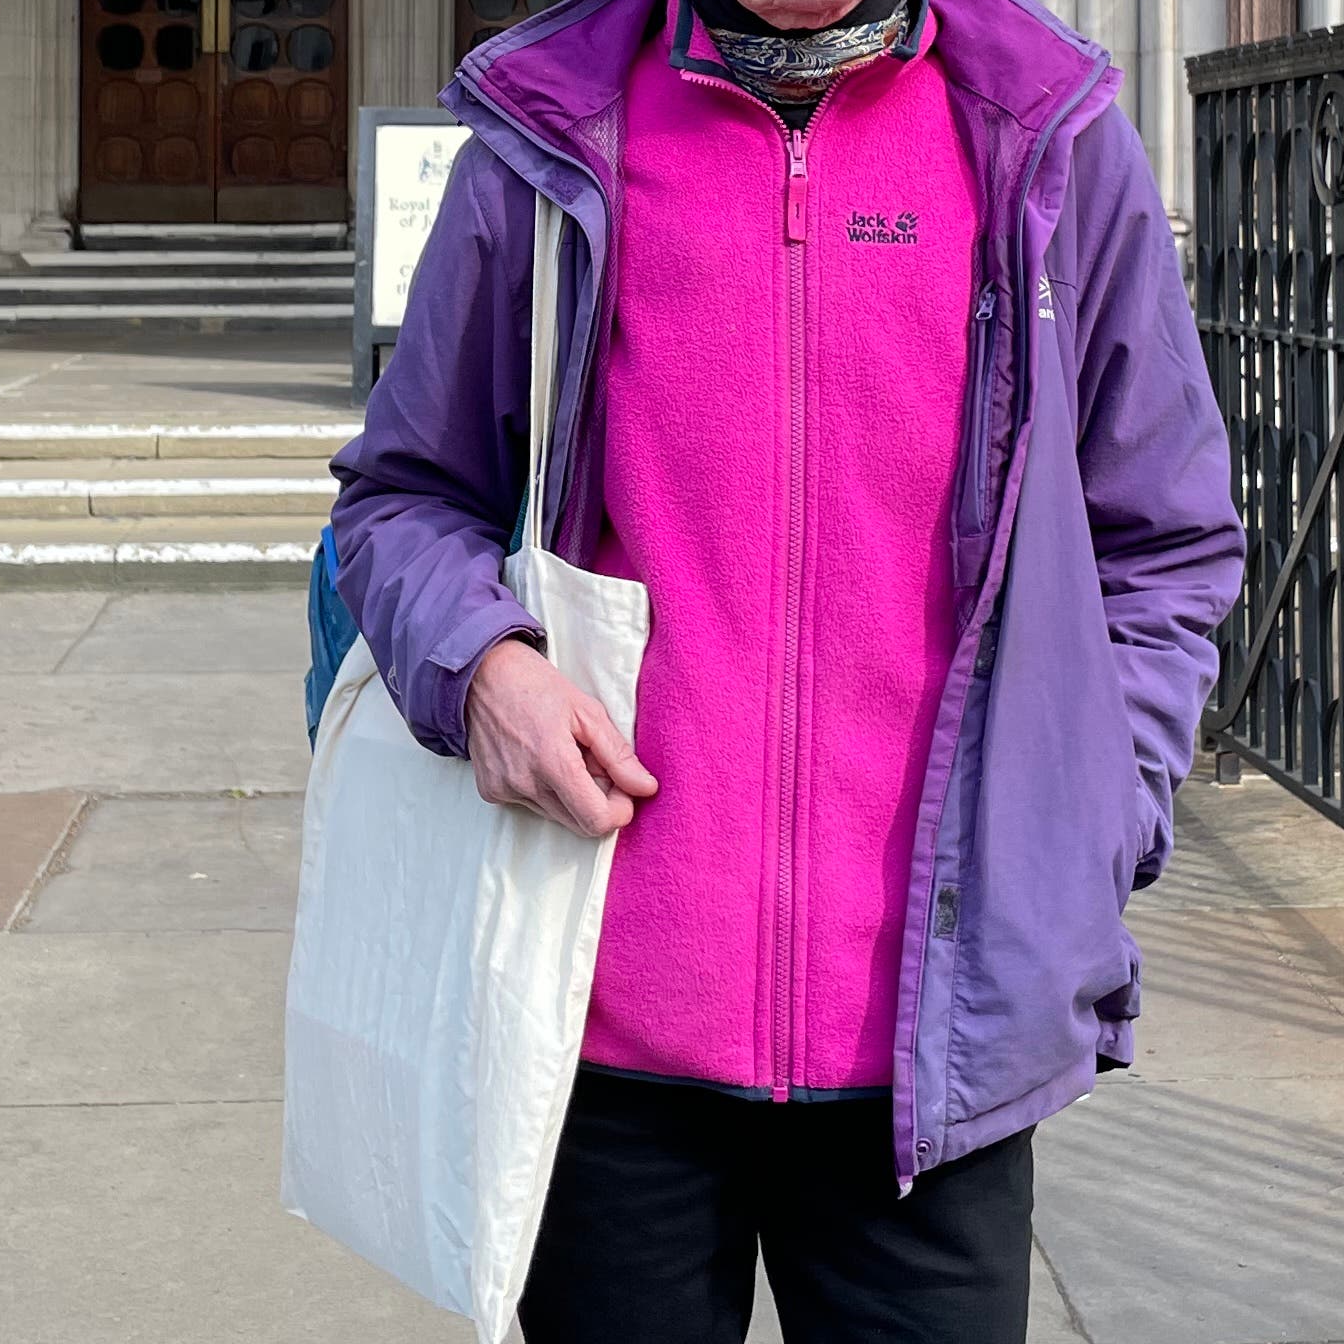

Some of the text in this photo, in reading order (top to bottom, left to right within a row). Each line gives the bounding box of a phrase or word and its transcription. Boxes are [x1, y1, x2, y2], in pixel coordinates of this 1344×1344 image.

[388, 196, 431, 213] Royal
[399, 214, 416, 228] of
[846, 211, 888, 228] Jack
[846, 226, 918, 244] Wolfskin
